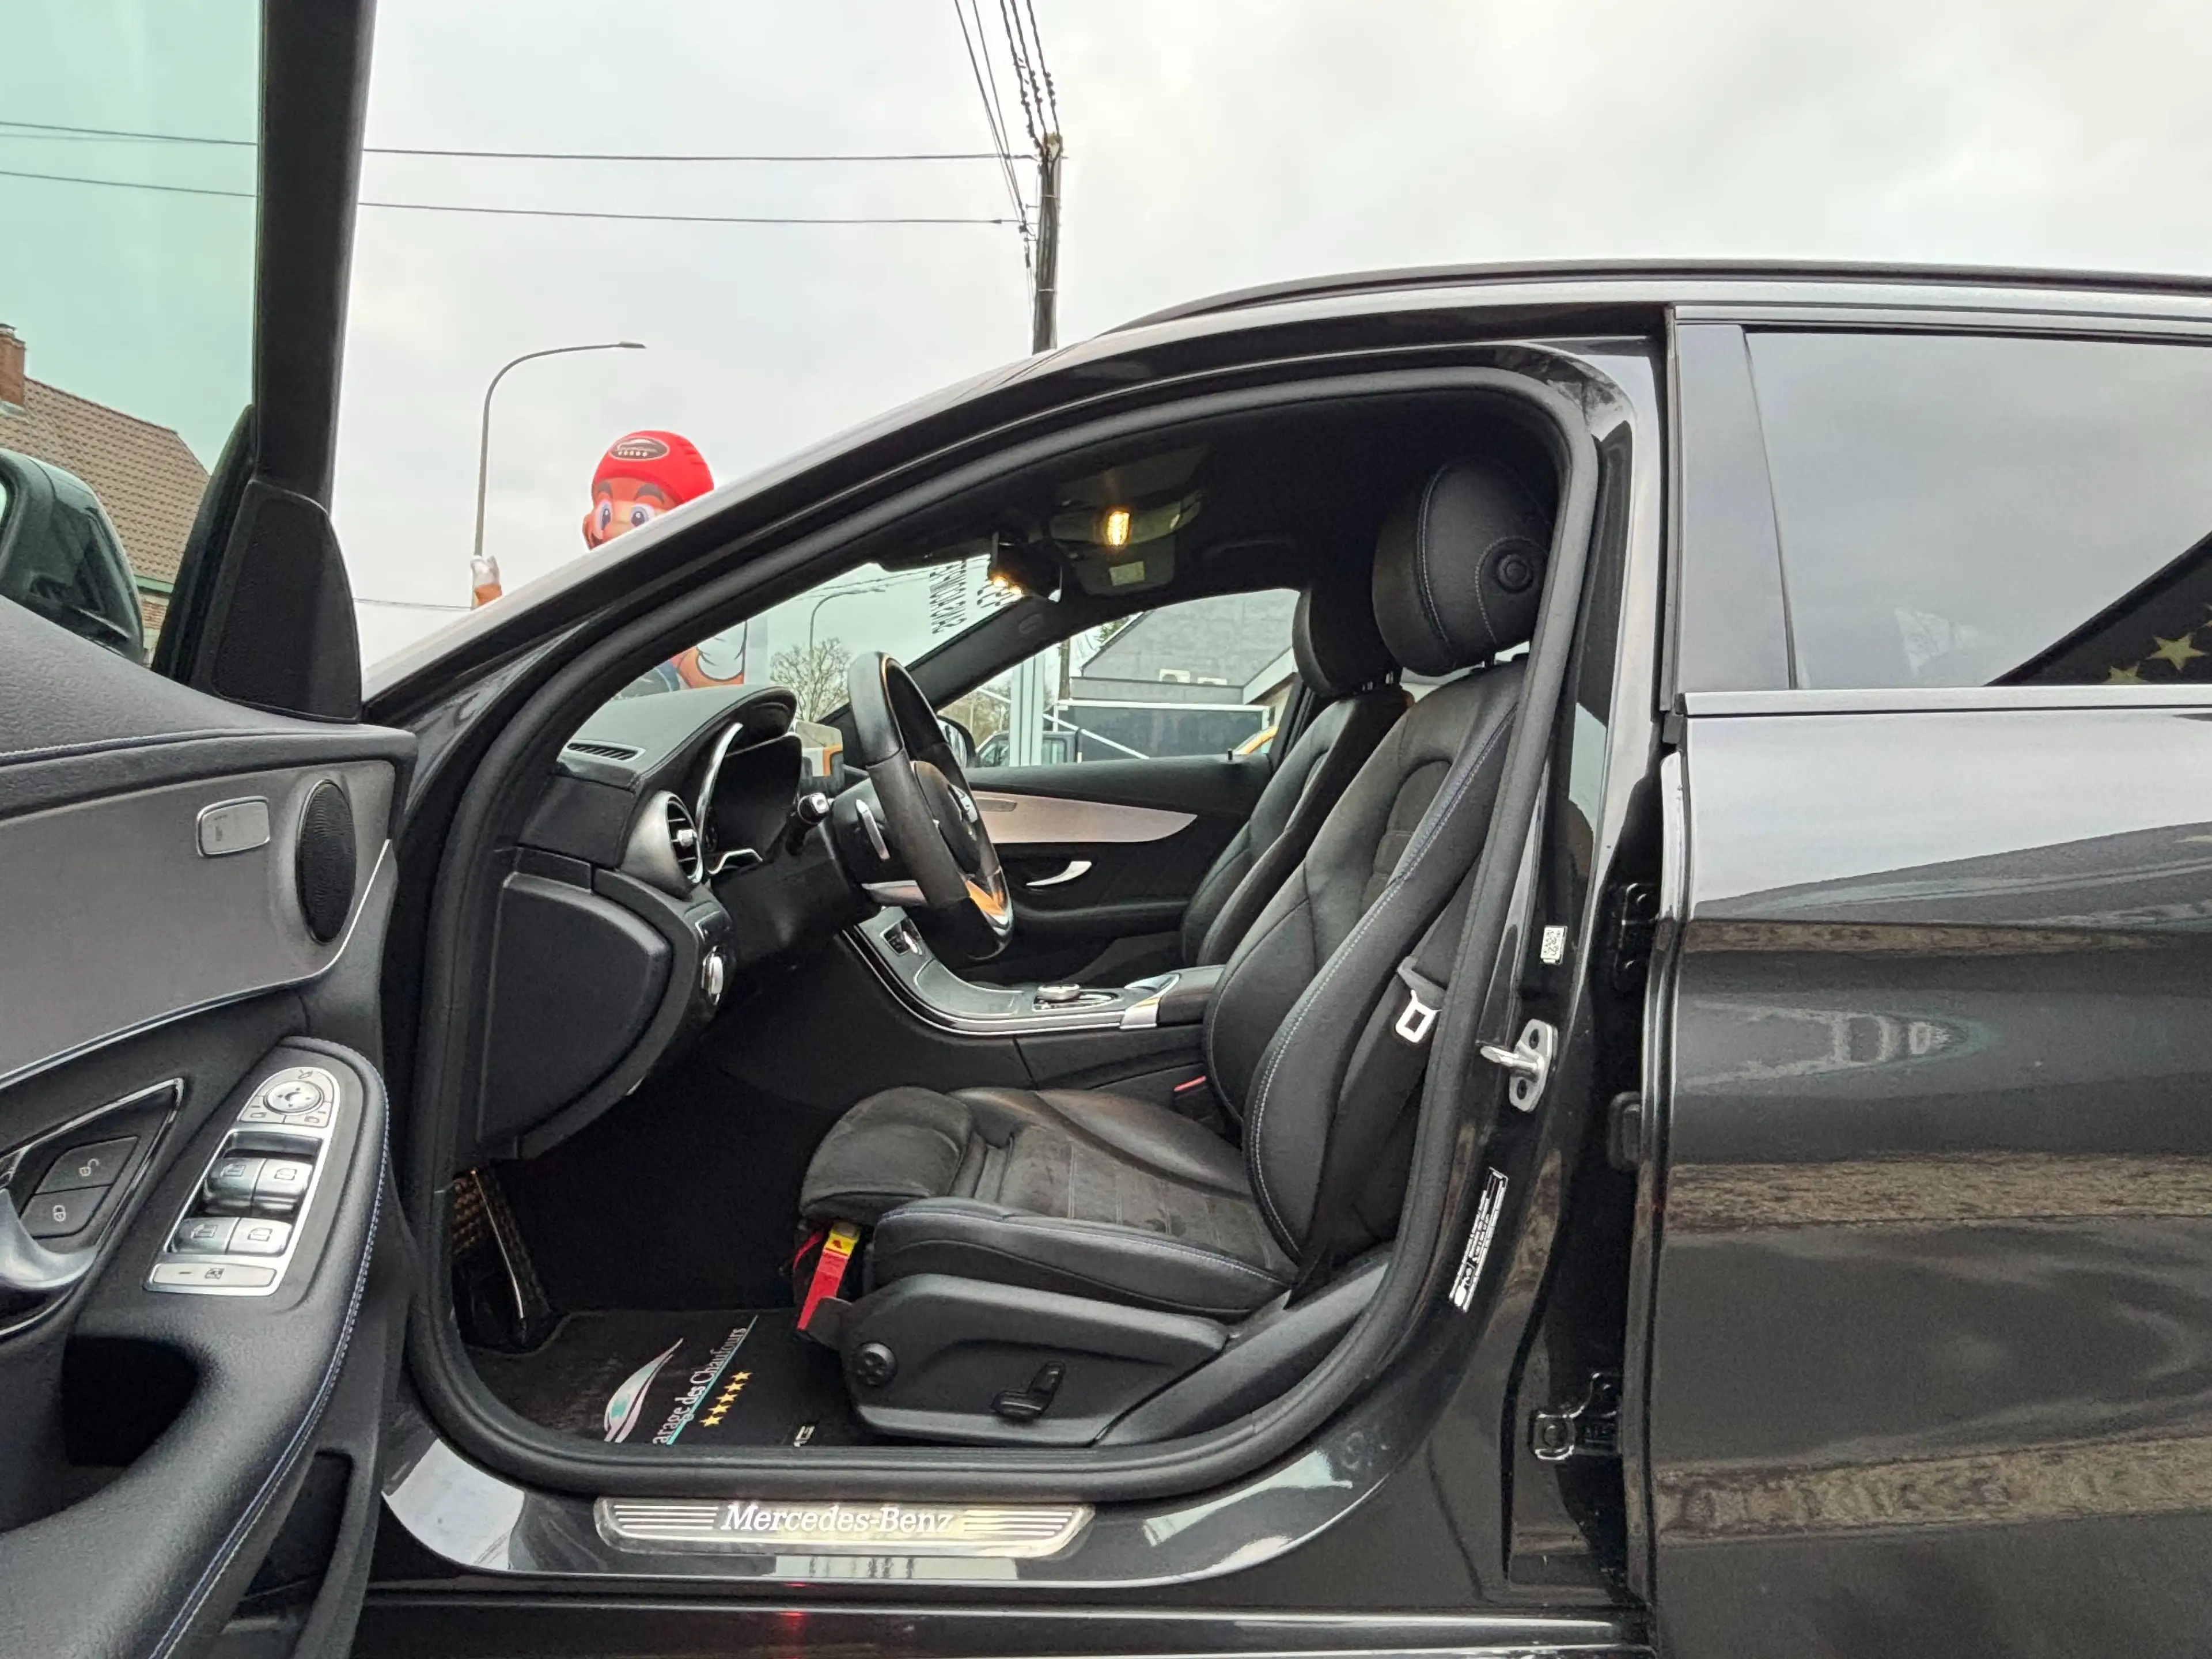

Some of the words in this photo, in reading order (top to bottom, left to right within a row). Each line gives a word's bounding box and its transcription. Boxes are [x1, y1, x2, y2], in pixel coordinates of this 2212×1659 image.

[690, 1327, 748, 1384] Chaufours
[675, 1385, 706, 1405] des
[652, 1406, 695, 1445] arage
[721, 1502, 954, 1533] Mercedes-Benz
